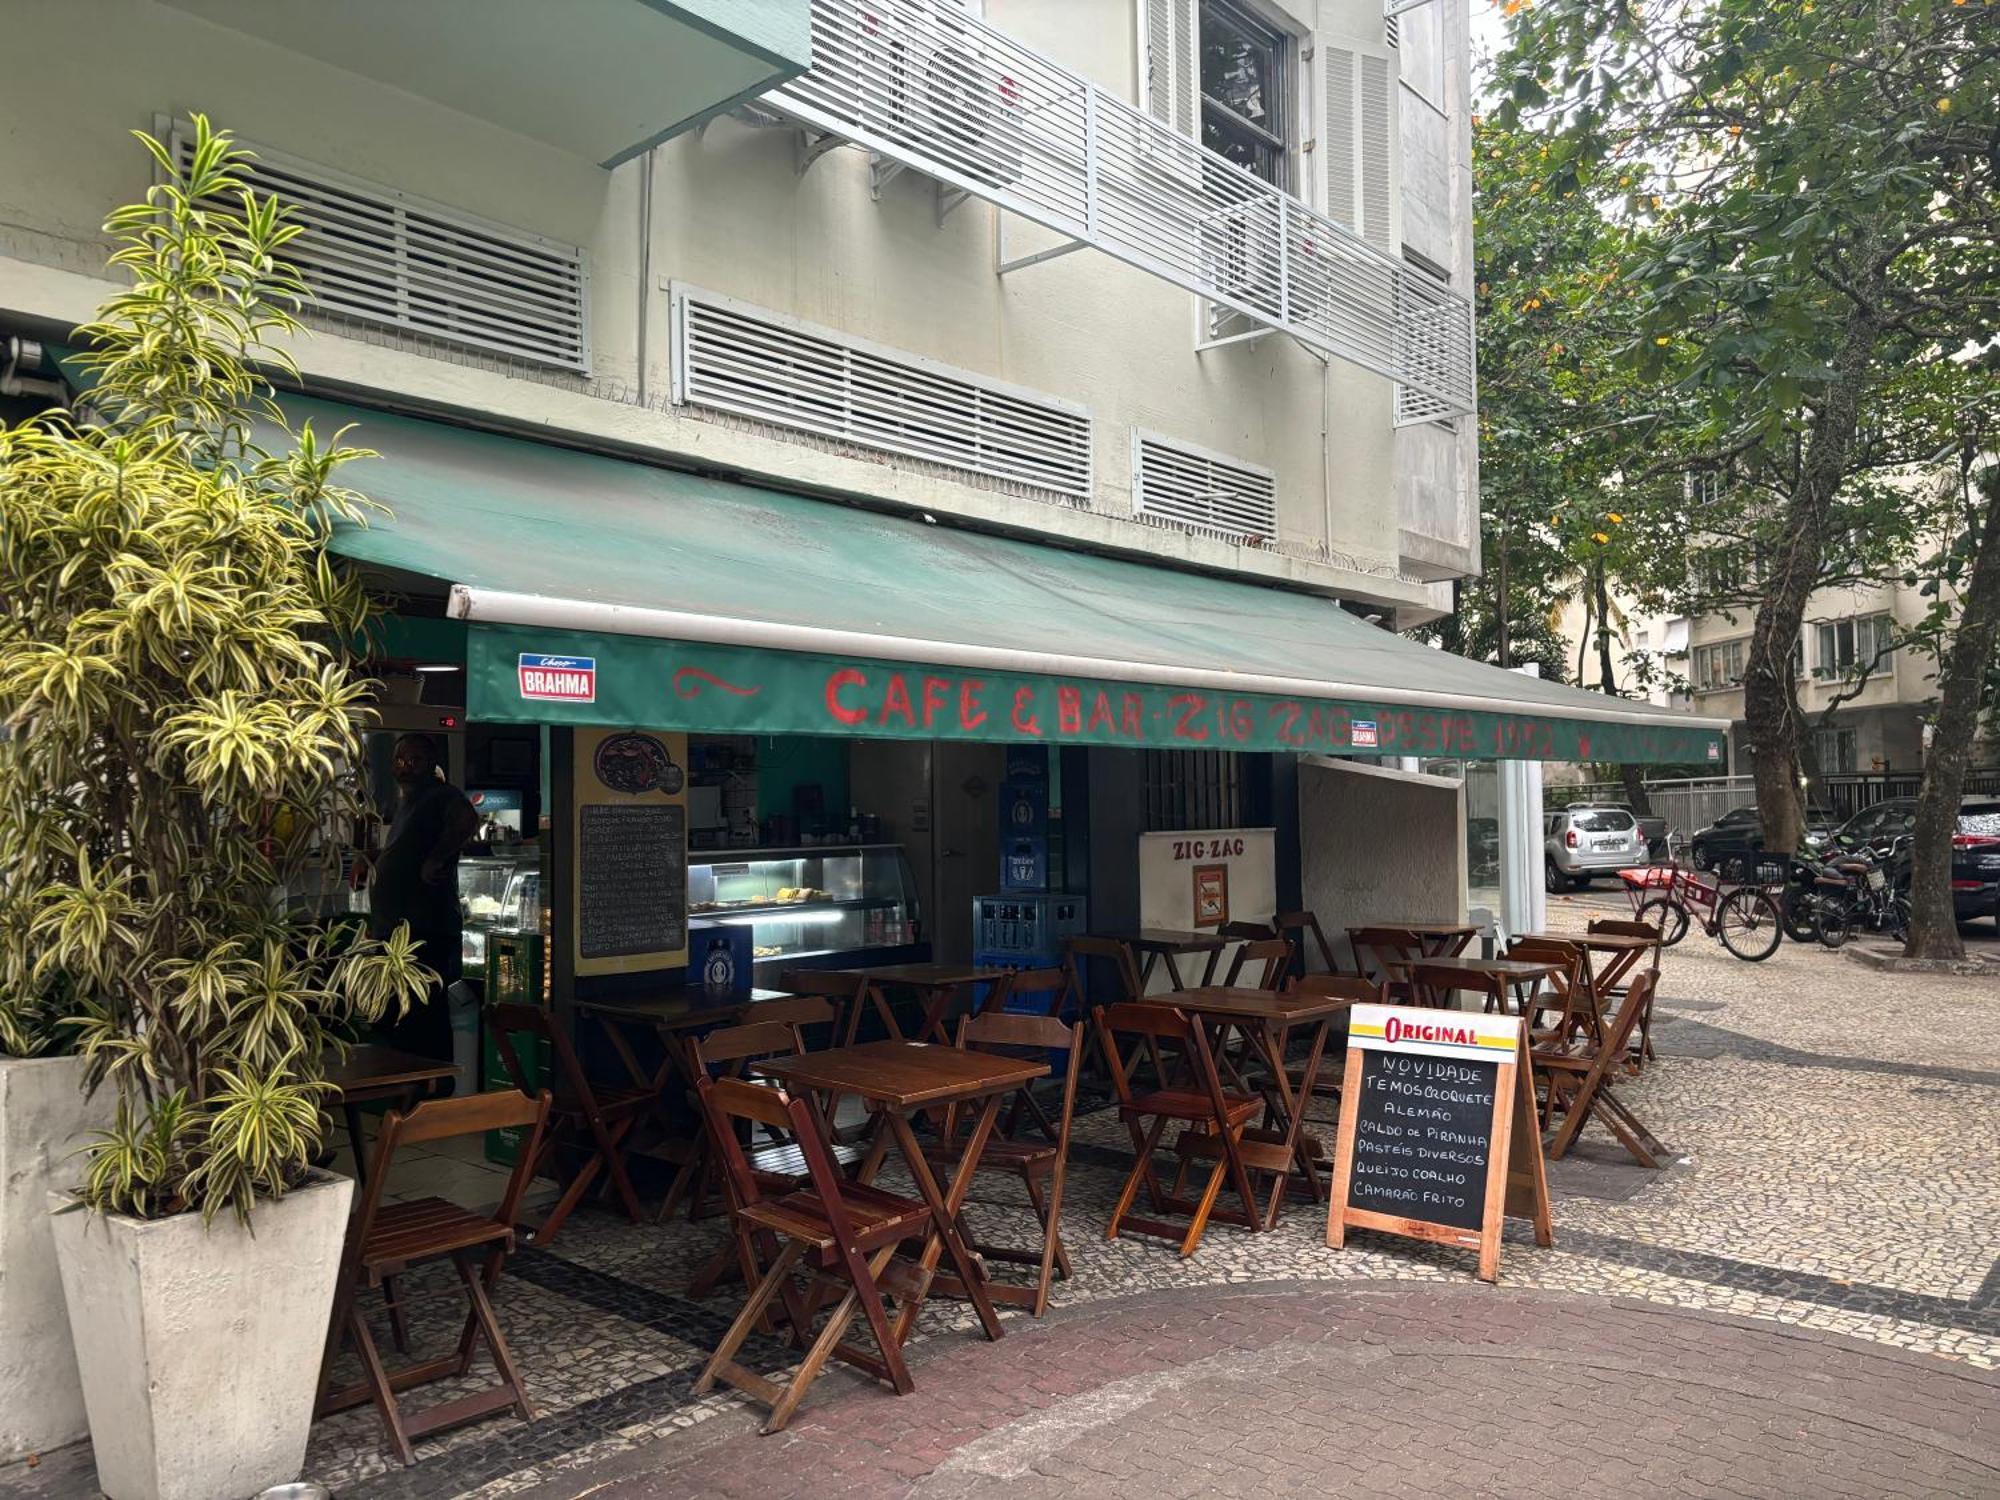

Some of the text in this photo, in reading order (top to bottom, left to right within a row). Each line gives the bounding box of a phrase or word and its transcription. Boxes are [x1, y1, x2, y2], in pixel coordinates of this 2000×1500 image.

[524, 671, 589, 695] BRAHMA
[824, 667, 988, 731] CAFE
[1010, 686, 1042, 736] &
[1057, 685, 1144, 742] BAR
[1165, 694, 1253, 742] ZIG
[1385, 1017, 1478, 1044] ORIGINAL
[1383, 1056, 1482, 1082] NOVIDADE
[1366, 1075, 1493, 1105] TEMOS CROQUETE
[1384, 1102, 1452, 1121] ALEMÃO
[1359, 1119, 1403, 1137] CALDO
[1407, 1128, 1421, 1137] DE
[1417, 1147, 1485, 1166] DIVERSOS
[1412, 1168, 1466, 1185] COALHO
[1354, 1181, 1466, 1208] CAMARÃO FRITO
